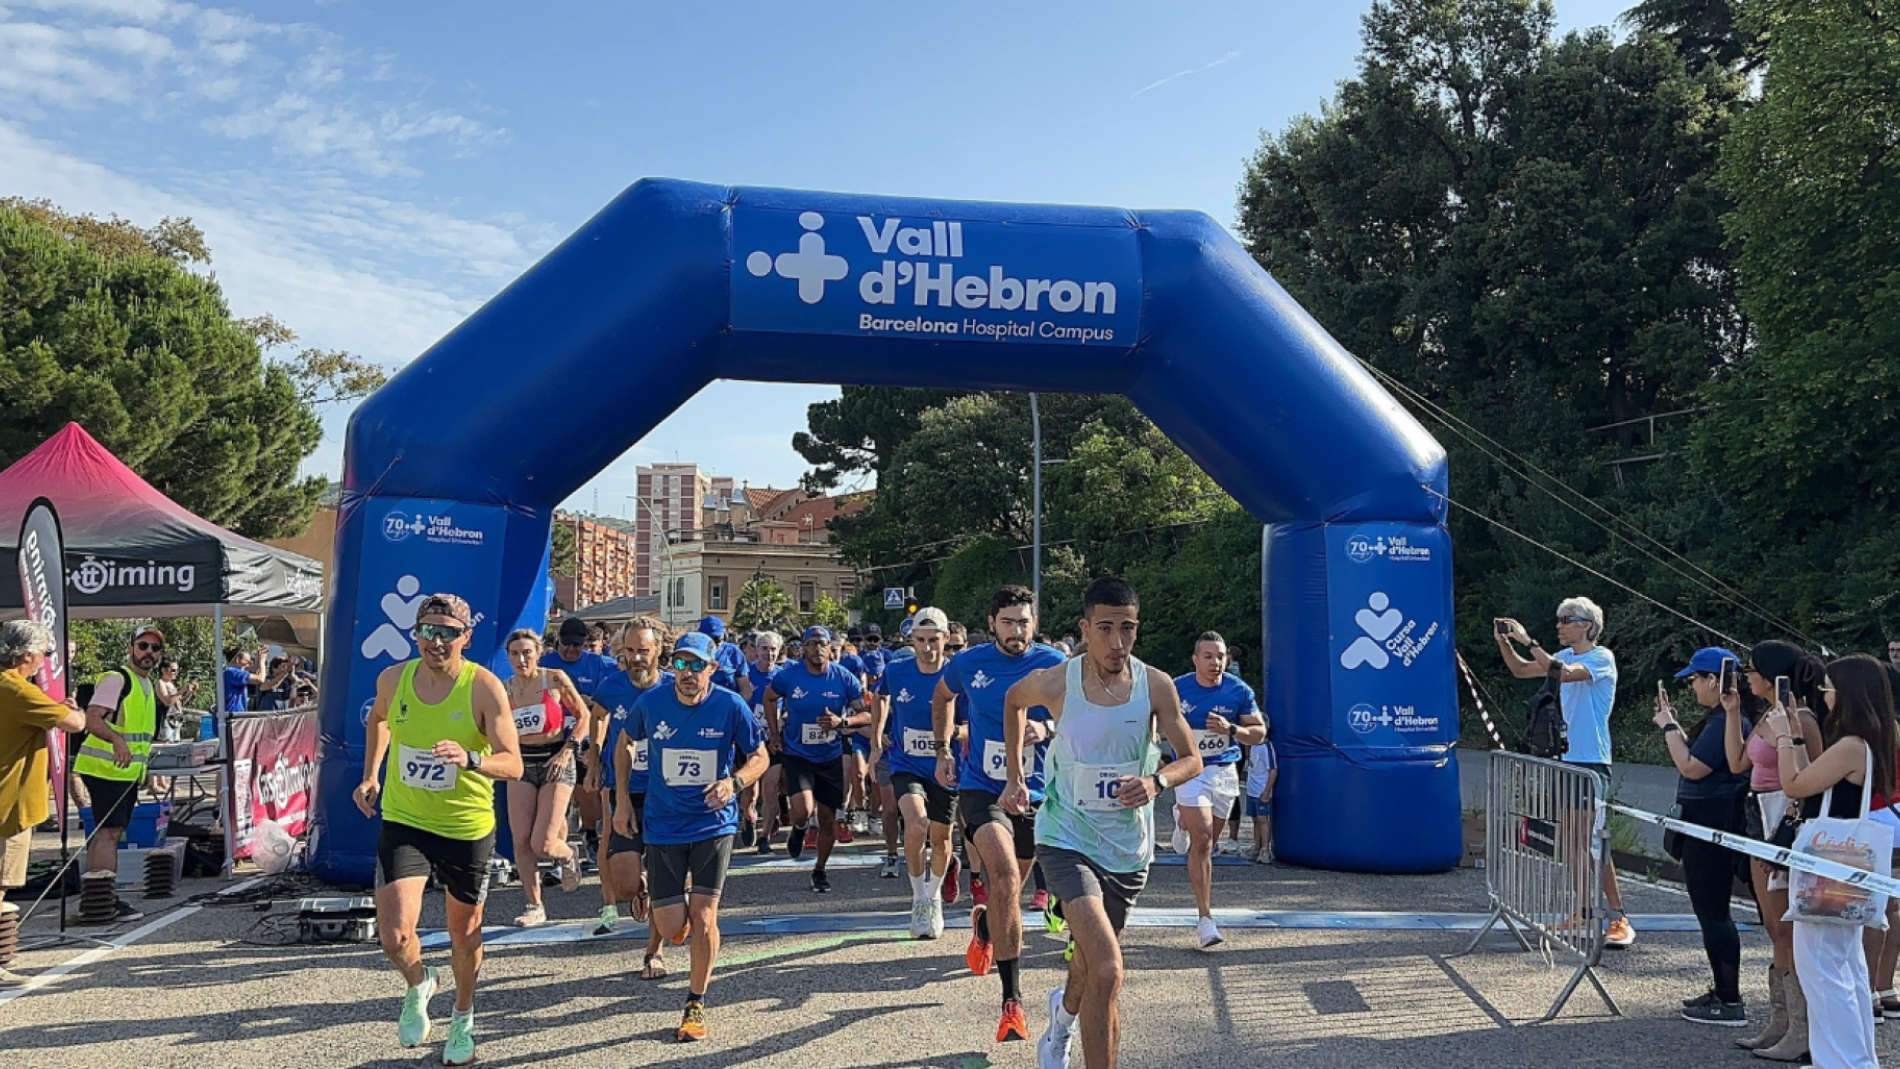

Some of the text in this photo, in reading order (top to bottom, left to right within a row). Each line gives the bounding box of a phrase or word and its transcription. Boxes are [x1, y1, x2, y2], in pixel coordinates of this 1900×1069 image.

[857, 216, 963, 257] Vall
[859, 260, 1117, 314] d'Hebron
[858, 314, 1114, 344] Barcelona Hospital Campus
[386, 518, 404, 530] 70
[428, 515, 452, 526] Vall
[427, 526, 483, 539] d'Hebron
[1350, 541, 1368, 552] 70
[1387, 537, 1407, 546] Vall
[1388, 545, 1430, 555] d'Hebron
[1386, 619, 1416, 650] Cursa
[1393, 636, 1415, 658] Vall
[1403, 621, 1439, 667] d'Hebron
[1352, 711, 1371, 722] 70
[1393, 705, 1414, 715] Vall
[515, 715, 540, 729] 359
[1394, 716, 1439, 726] d'Hebron
[1199, 738, 1224, 750] 666
[406, 761, 446, 781] 972
[678, 762, 701, 776] 73
